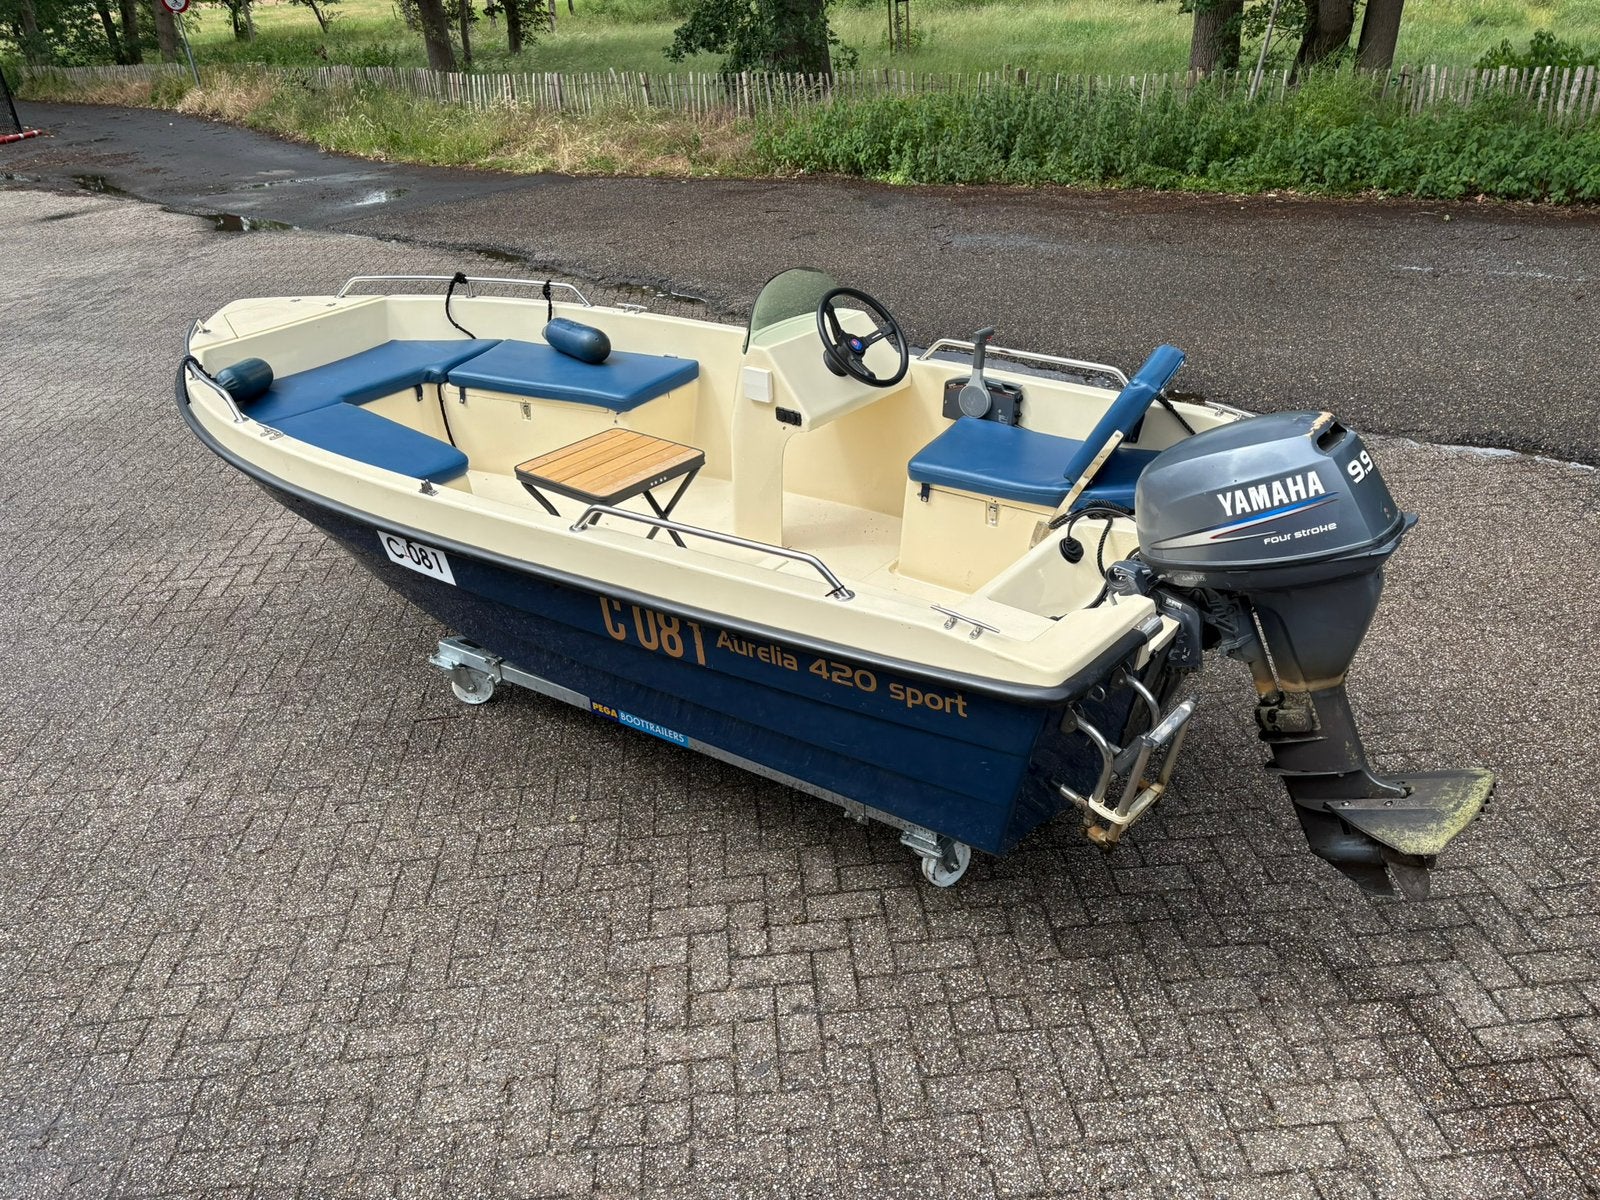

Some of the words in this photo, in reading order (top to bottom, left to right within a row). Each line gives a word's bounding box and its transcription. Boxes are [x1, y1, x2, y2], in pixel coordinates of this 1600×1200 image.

[1347, 450, 1373, 483] 9.9
[1217, 471, 1325, 516] YAMAHA
[600, 597, 626, 640] C
[632, 605, 705, 666] 081
[716, 630, 798, 672] Aurelia
[808, 658, 877, 692] 420
[889, 682, 967, 718] sport
[592, 702, 618, 718] PEGA
[620, 712, 685, 743] BOOTTRAILERS
